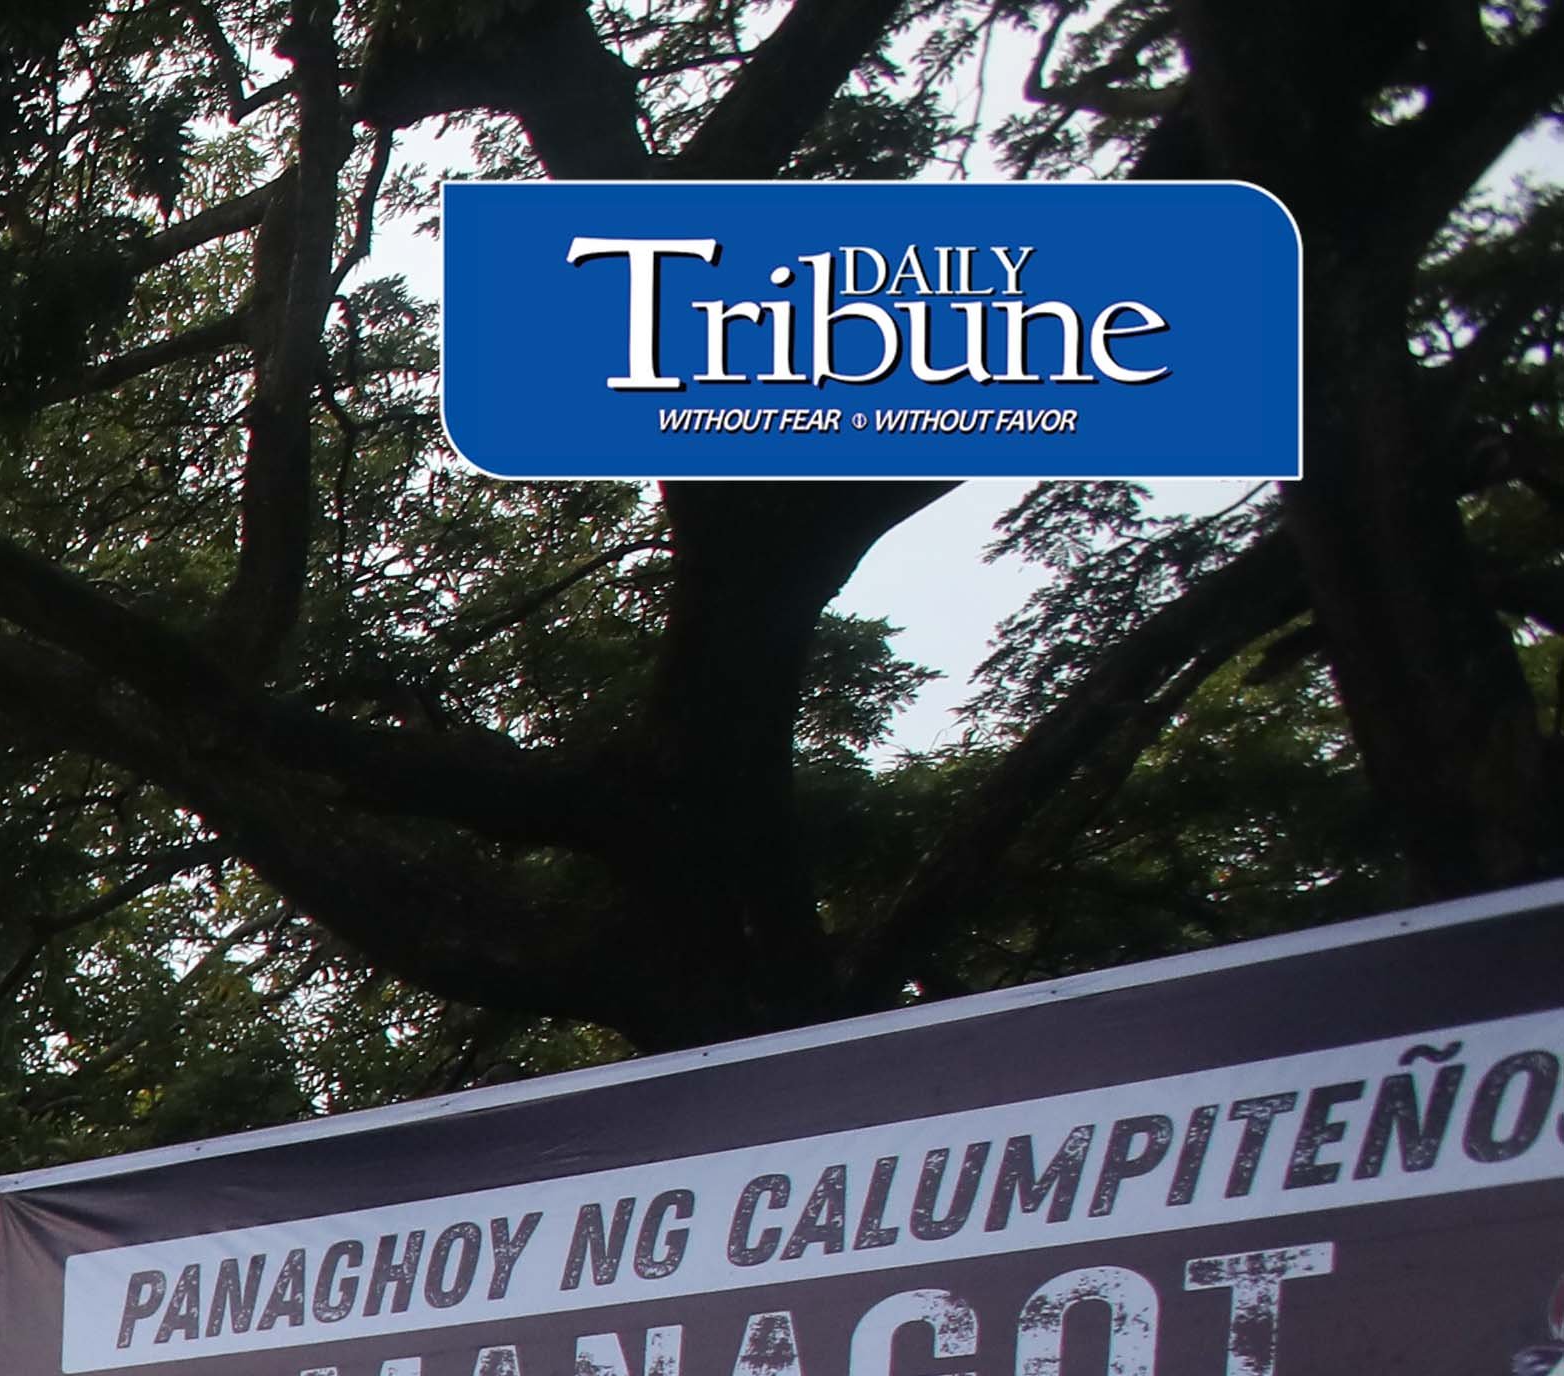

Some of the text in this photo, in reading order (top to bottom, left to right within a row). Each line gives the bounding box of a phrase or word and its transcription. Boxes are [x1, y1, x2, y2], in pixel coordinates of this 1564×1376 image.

[116, 1041, 1564, 1349] PANAGHOY NG CALUMPITEÑO
